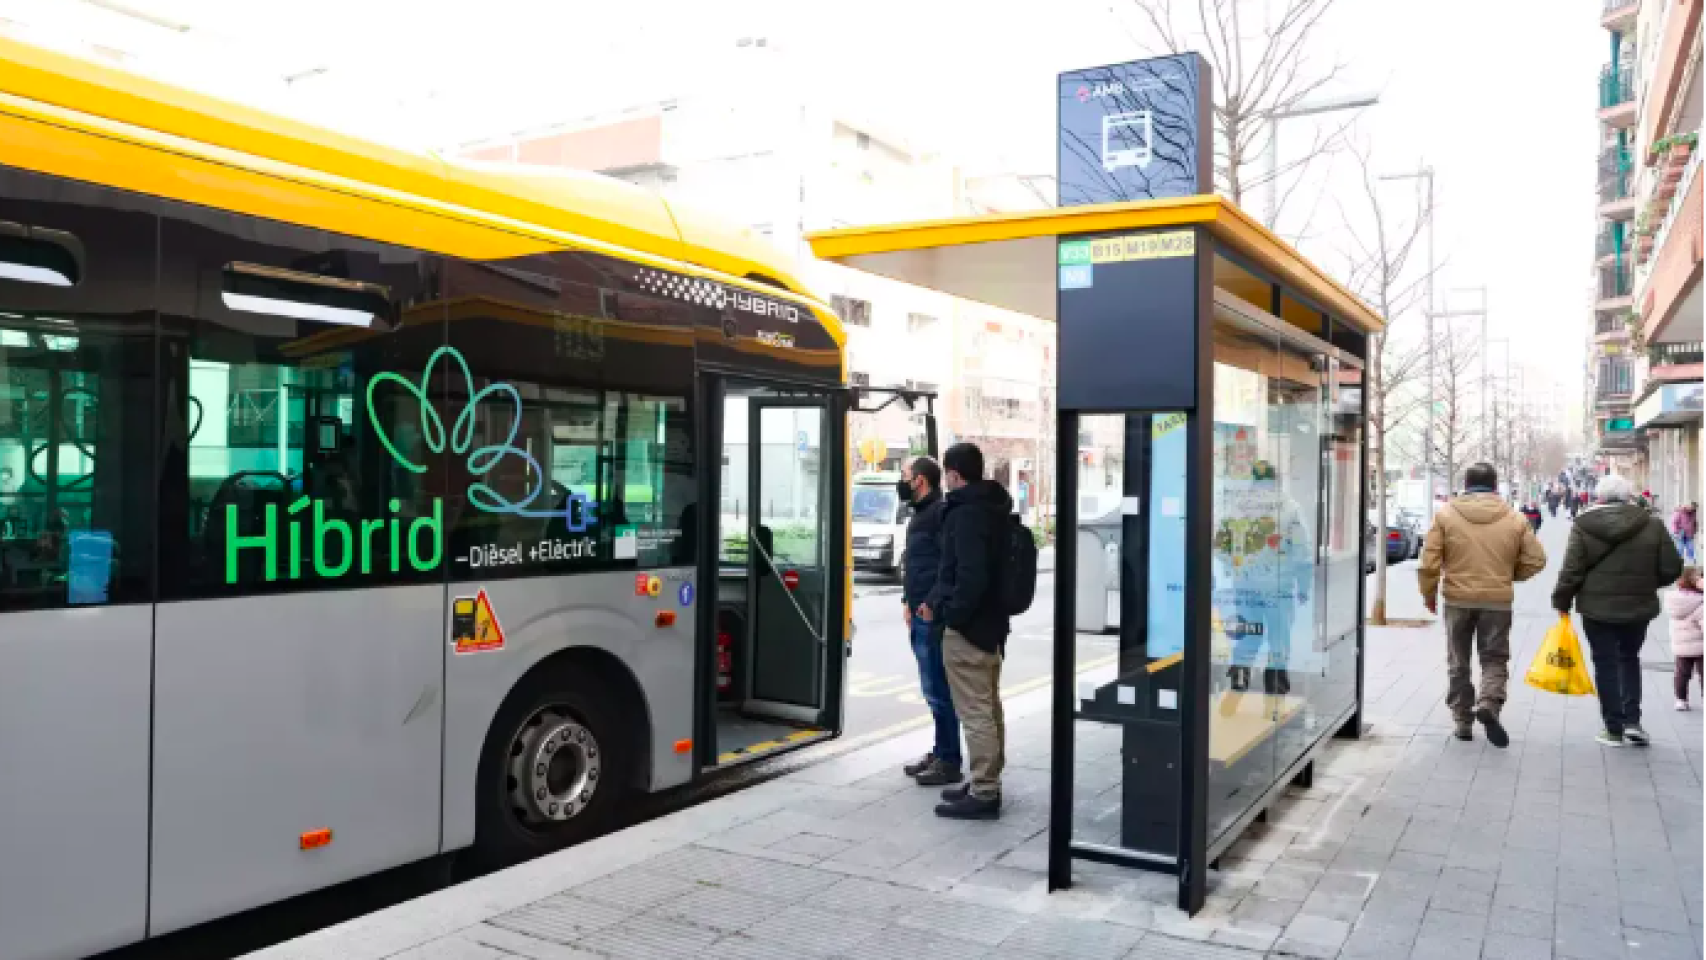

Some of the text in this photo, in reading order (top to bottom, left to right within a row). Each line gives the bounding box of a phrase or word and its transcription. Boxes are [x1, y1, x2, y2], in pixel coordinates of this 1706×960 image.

[1093, 83, 1123, 97] AMB
[1093, 243, 1121, 257] B15
[1127, 240, 1157, 254] M19
[1162, 236, 1193, 252] M28
[723, 291, 798, 323] HYBRID
[226, 495, 443, 584] Híbrid
